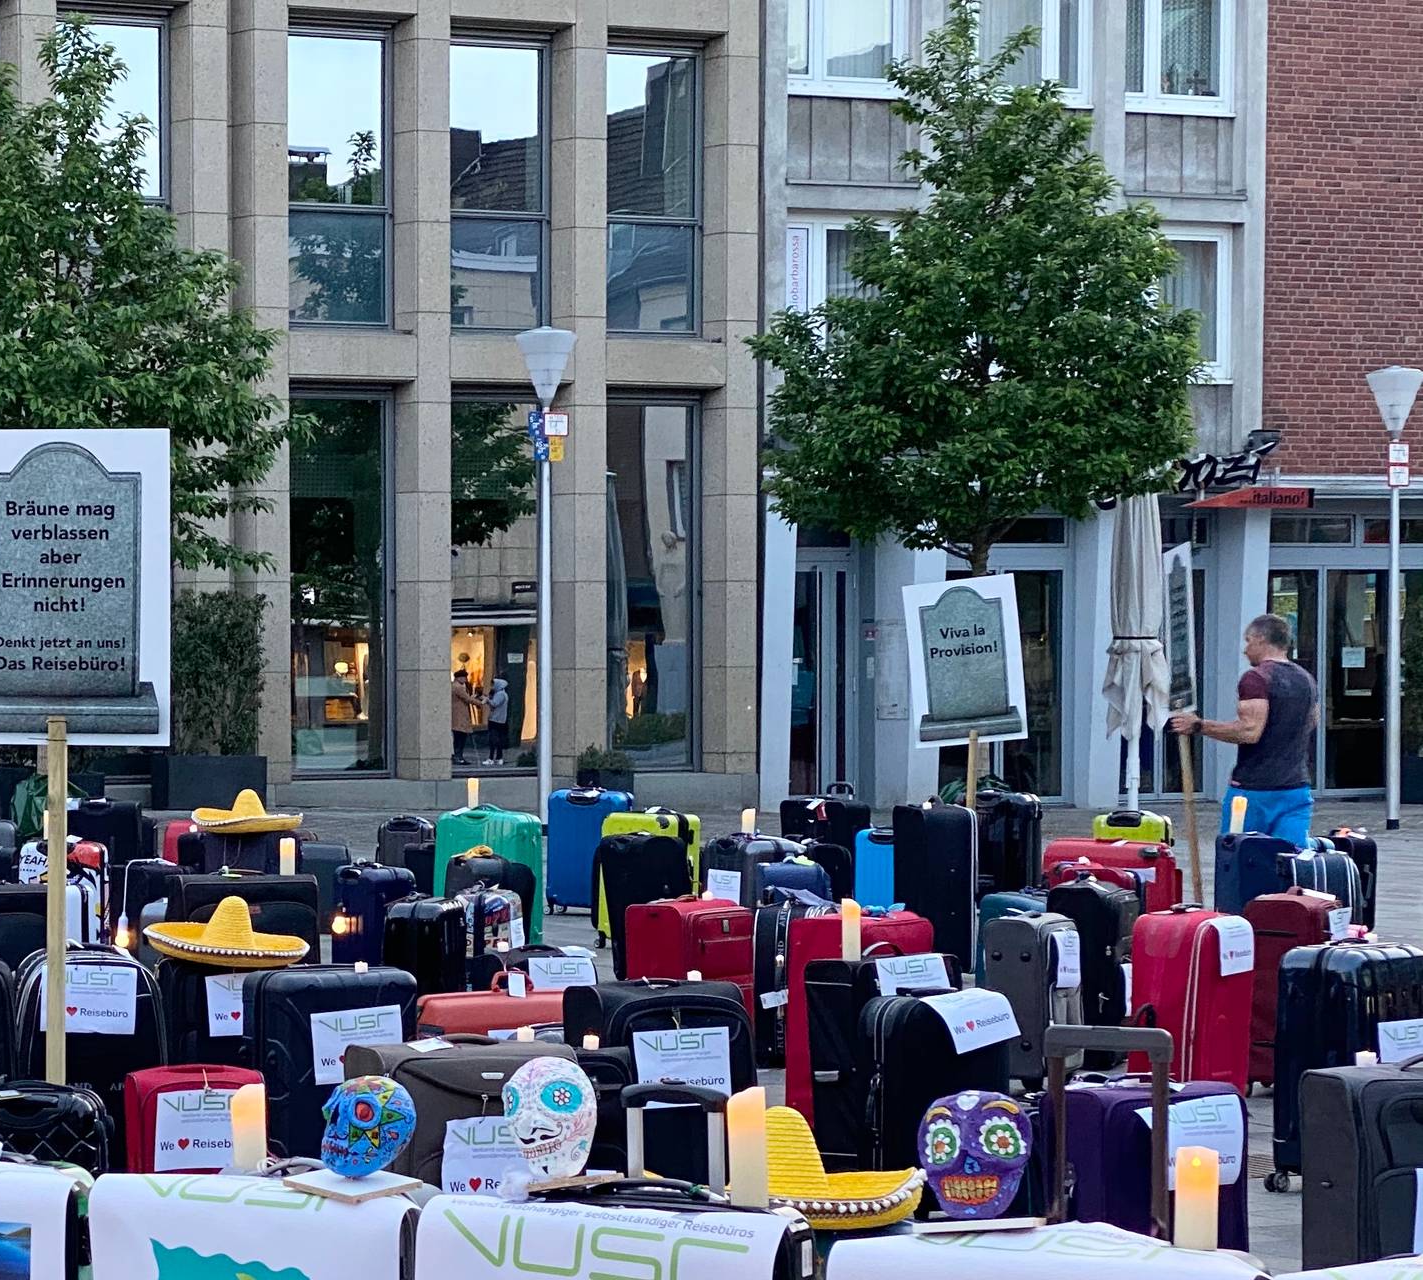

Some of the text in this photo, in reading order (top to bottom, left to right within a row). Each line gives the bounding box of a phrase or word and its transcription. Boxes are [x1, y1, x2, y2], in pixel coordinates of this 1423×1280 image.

[5, 500, 115, 520] Bräune mag
[11, 525, 109, 541] verblassen
[39, 549, 81, 564] aber
[2, 572, 126, 593] Erinnerungen
[33, 597, 86, 612] nicht!
[939, 624, 986, 640] Viva la
[39, 637, 73, 651] jetzt
[76, 640, 92, 649] an
[97, 636, 126, 649] uns!
[930, 640, 999, 659] Provision!
[32, 656, 126, 671] Reisebüro!
[79, 1007, 129, 1018] Reisebüro
[215, 1012, 229, 1021] We
[953, 1025, 967, 1036] We
[321, 1057, 336, 1067] We
[160, 1141, 175, 1151] We
[450, 1182, 466, 1193] We
[683, 1219, 755, 1239] Reisebüros
